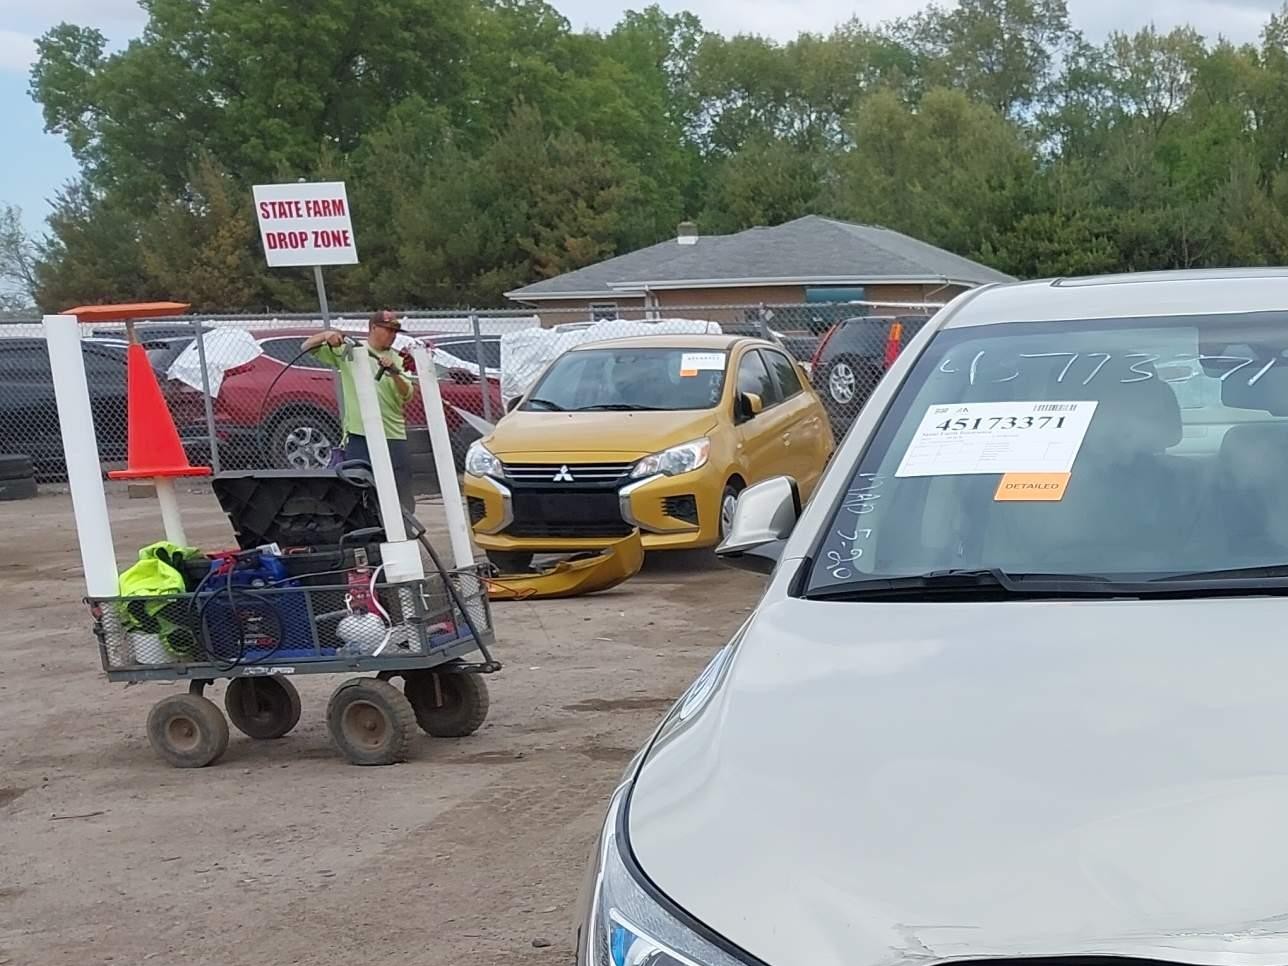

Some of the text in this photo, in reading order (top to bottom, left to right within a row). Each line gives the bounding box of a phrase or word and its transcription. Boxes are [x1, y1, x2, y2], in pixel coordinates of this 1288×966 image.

[259, 199, 346, 219] STATE FARM
[266, 229, 351, 249] DROP ZONE
[936, 415, 1067, 431] 45173371
[1004, 482, 1060, 491] DETAILED
